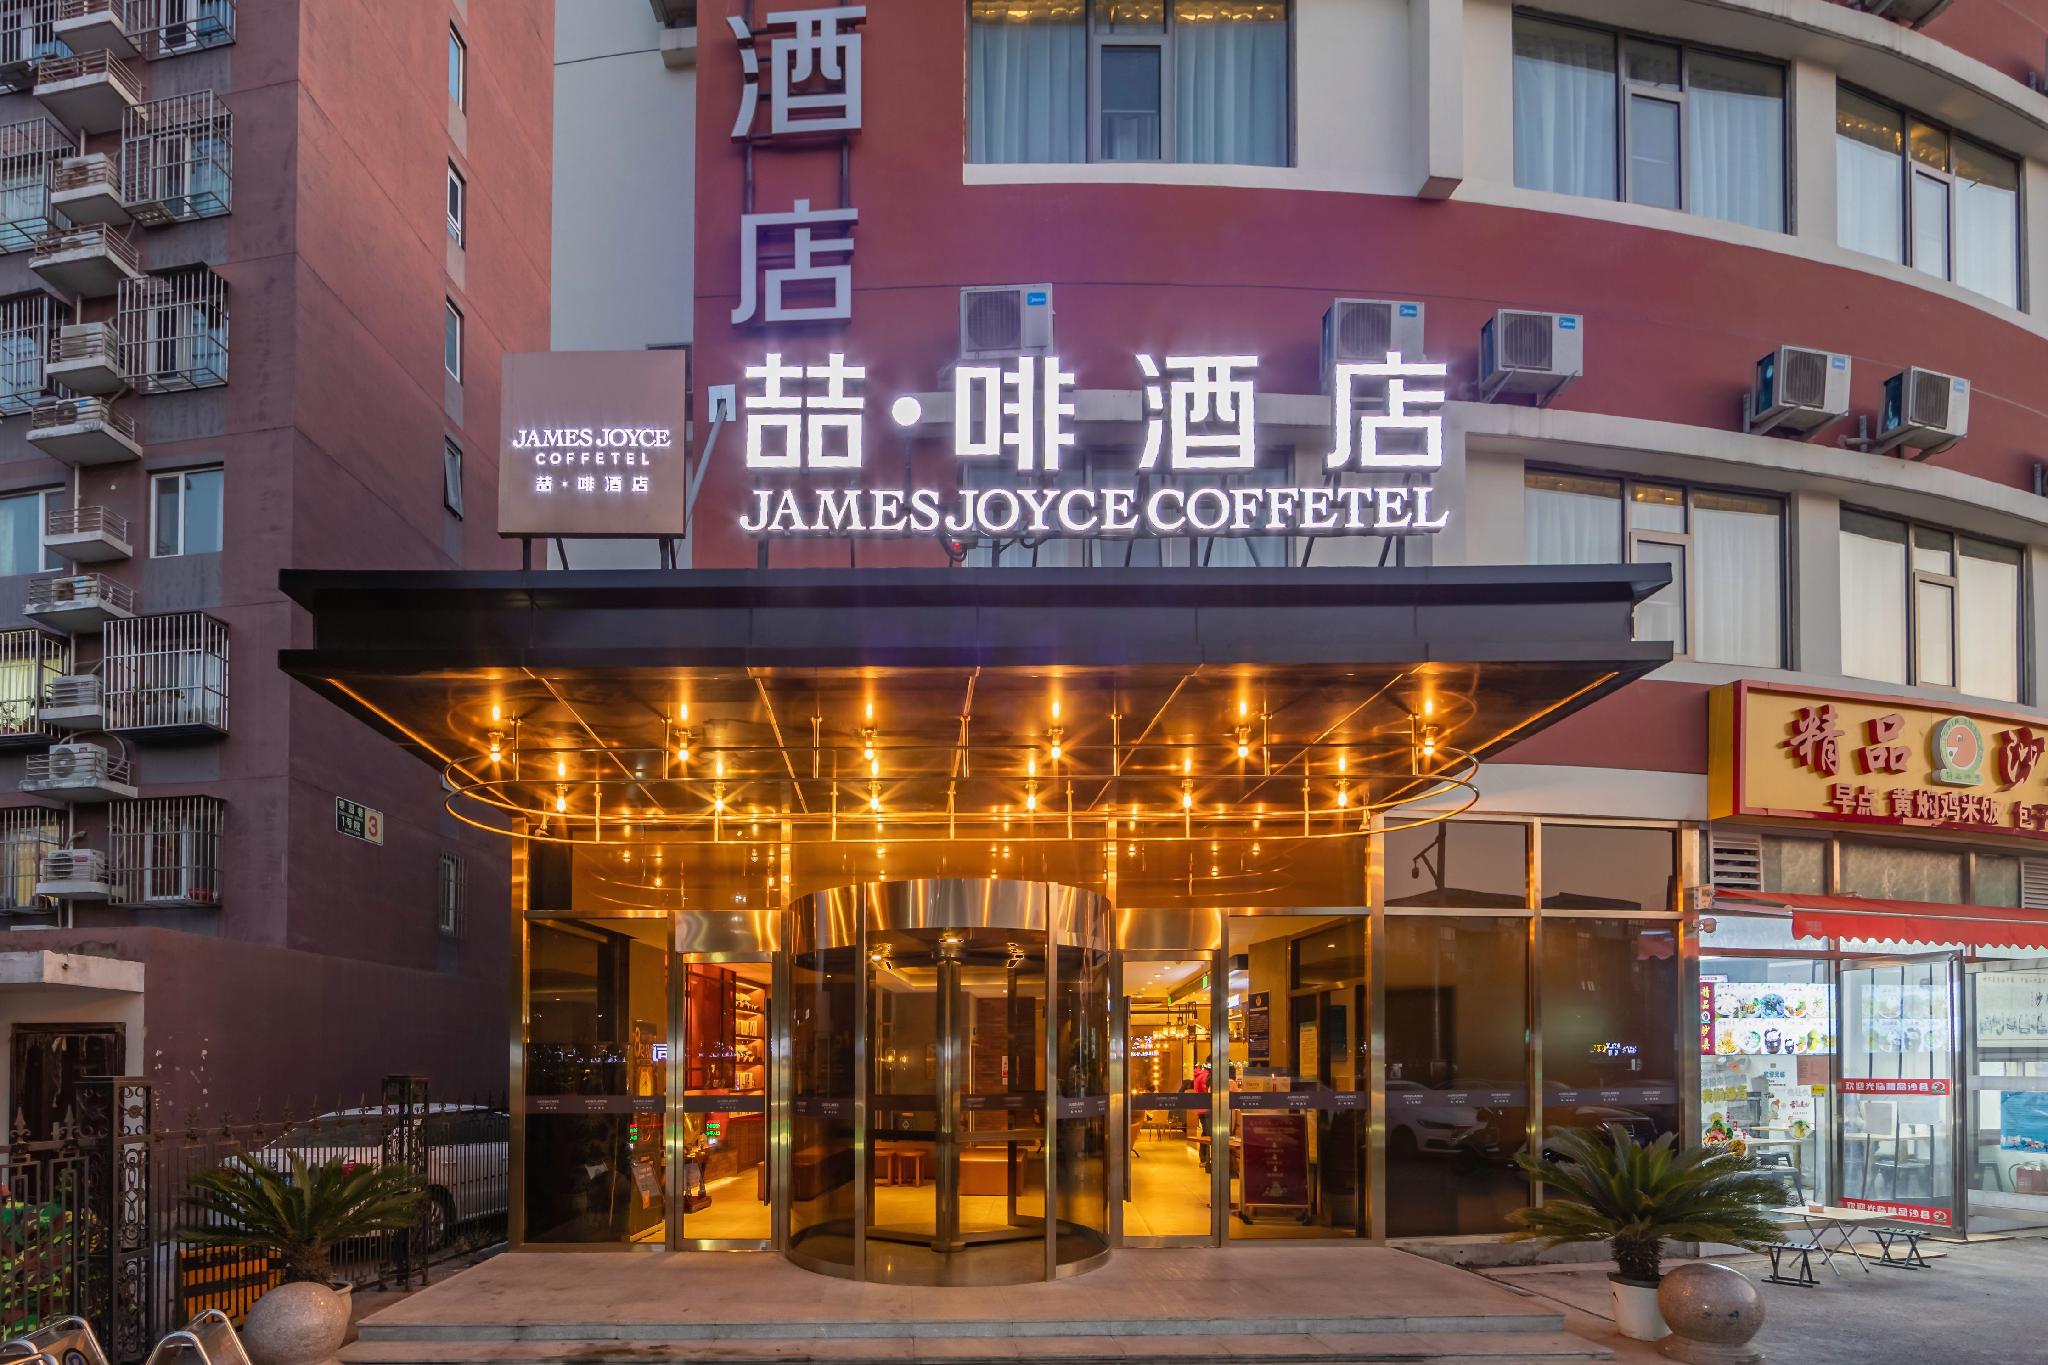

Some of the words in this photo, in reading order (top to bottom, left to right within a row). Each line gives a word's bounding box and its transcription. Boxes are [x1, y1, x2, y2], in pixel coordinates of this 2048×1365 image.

[730, 5, 867, 326] 酒店
[745, 351, 1448, 473] 喆·啡酒店
[512, 429, 593, 448] JAMES
[596, 428, 672, 448] JOYCE
[535, 452, 651, 466] COFFETEL
[740, 488, 941, 533] JAMES
[944, 488, 1139, 533] JOYCE
[1147, 487, 1450, 533] COFFETEL
[1785, 704, 1914, 777] 精品
[368, 815, 378, 838] 3
[1831, 783, 1876, 816] 早点
[1889, 787, 2001, 827] 黄焖鸡米饭
